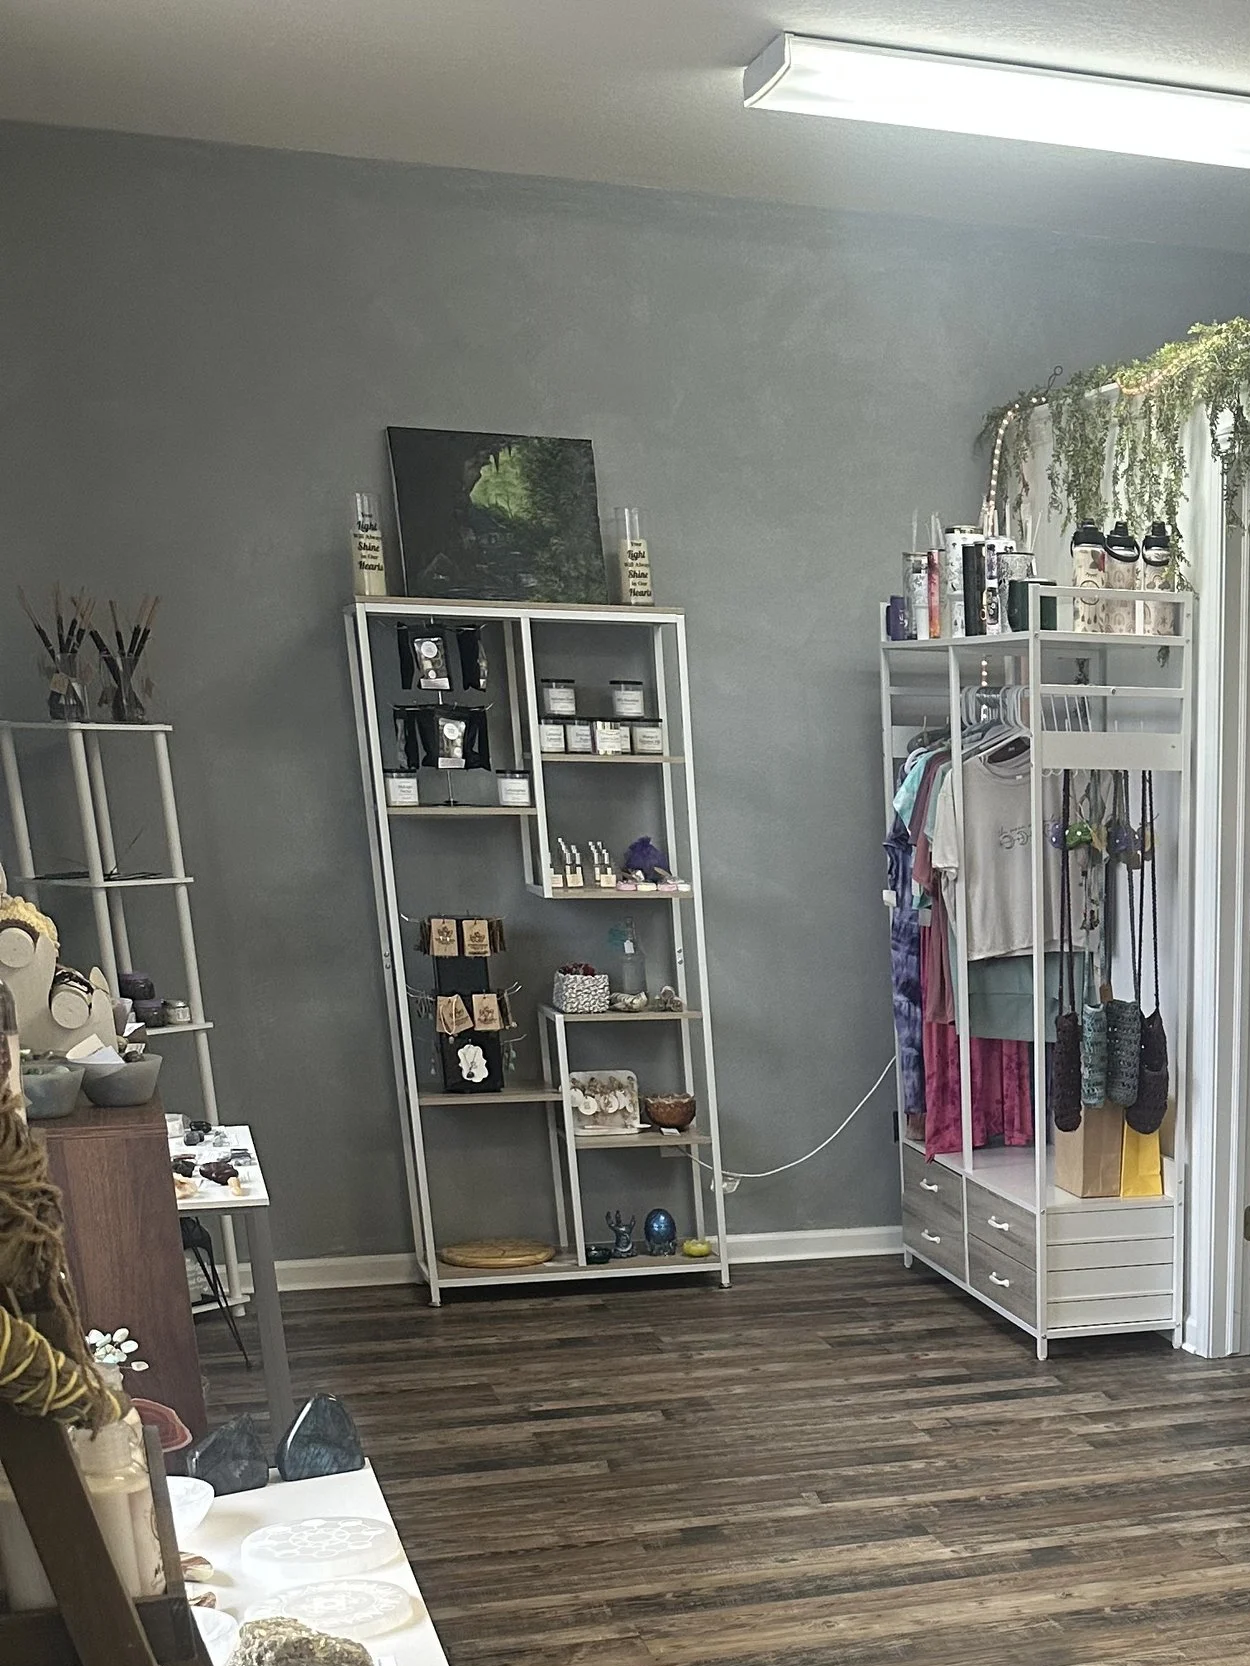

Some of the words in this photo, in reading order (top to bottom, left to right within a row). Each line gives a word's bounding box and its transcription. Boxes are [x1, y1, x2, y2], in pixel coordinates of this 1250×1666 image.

[357, 521, 378, 533] Light
[358, 542, 380, 552] Shine
[627, 550, 646, 561] Light
[358, 561, 384, 572] Hearts
[628, 570, 649, 579] Shine
[629, 588, 652, 597] Hearts
